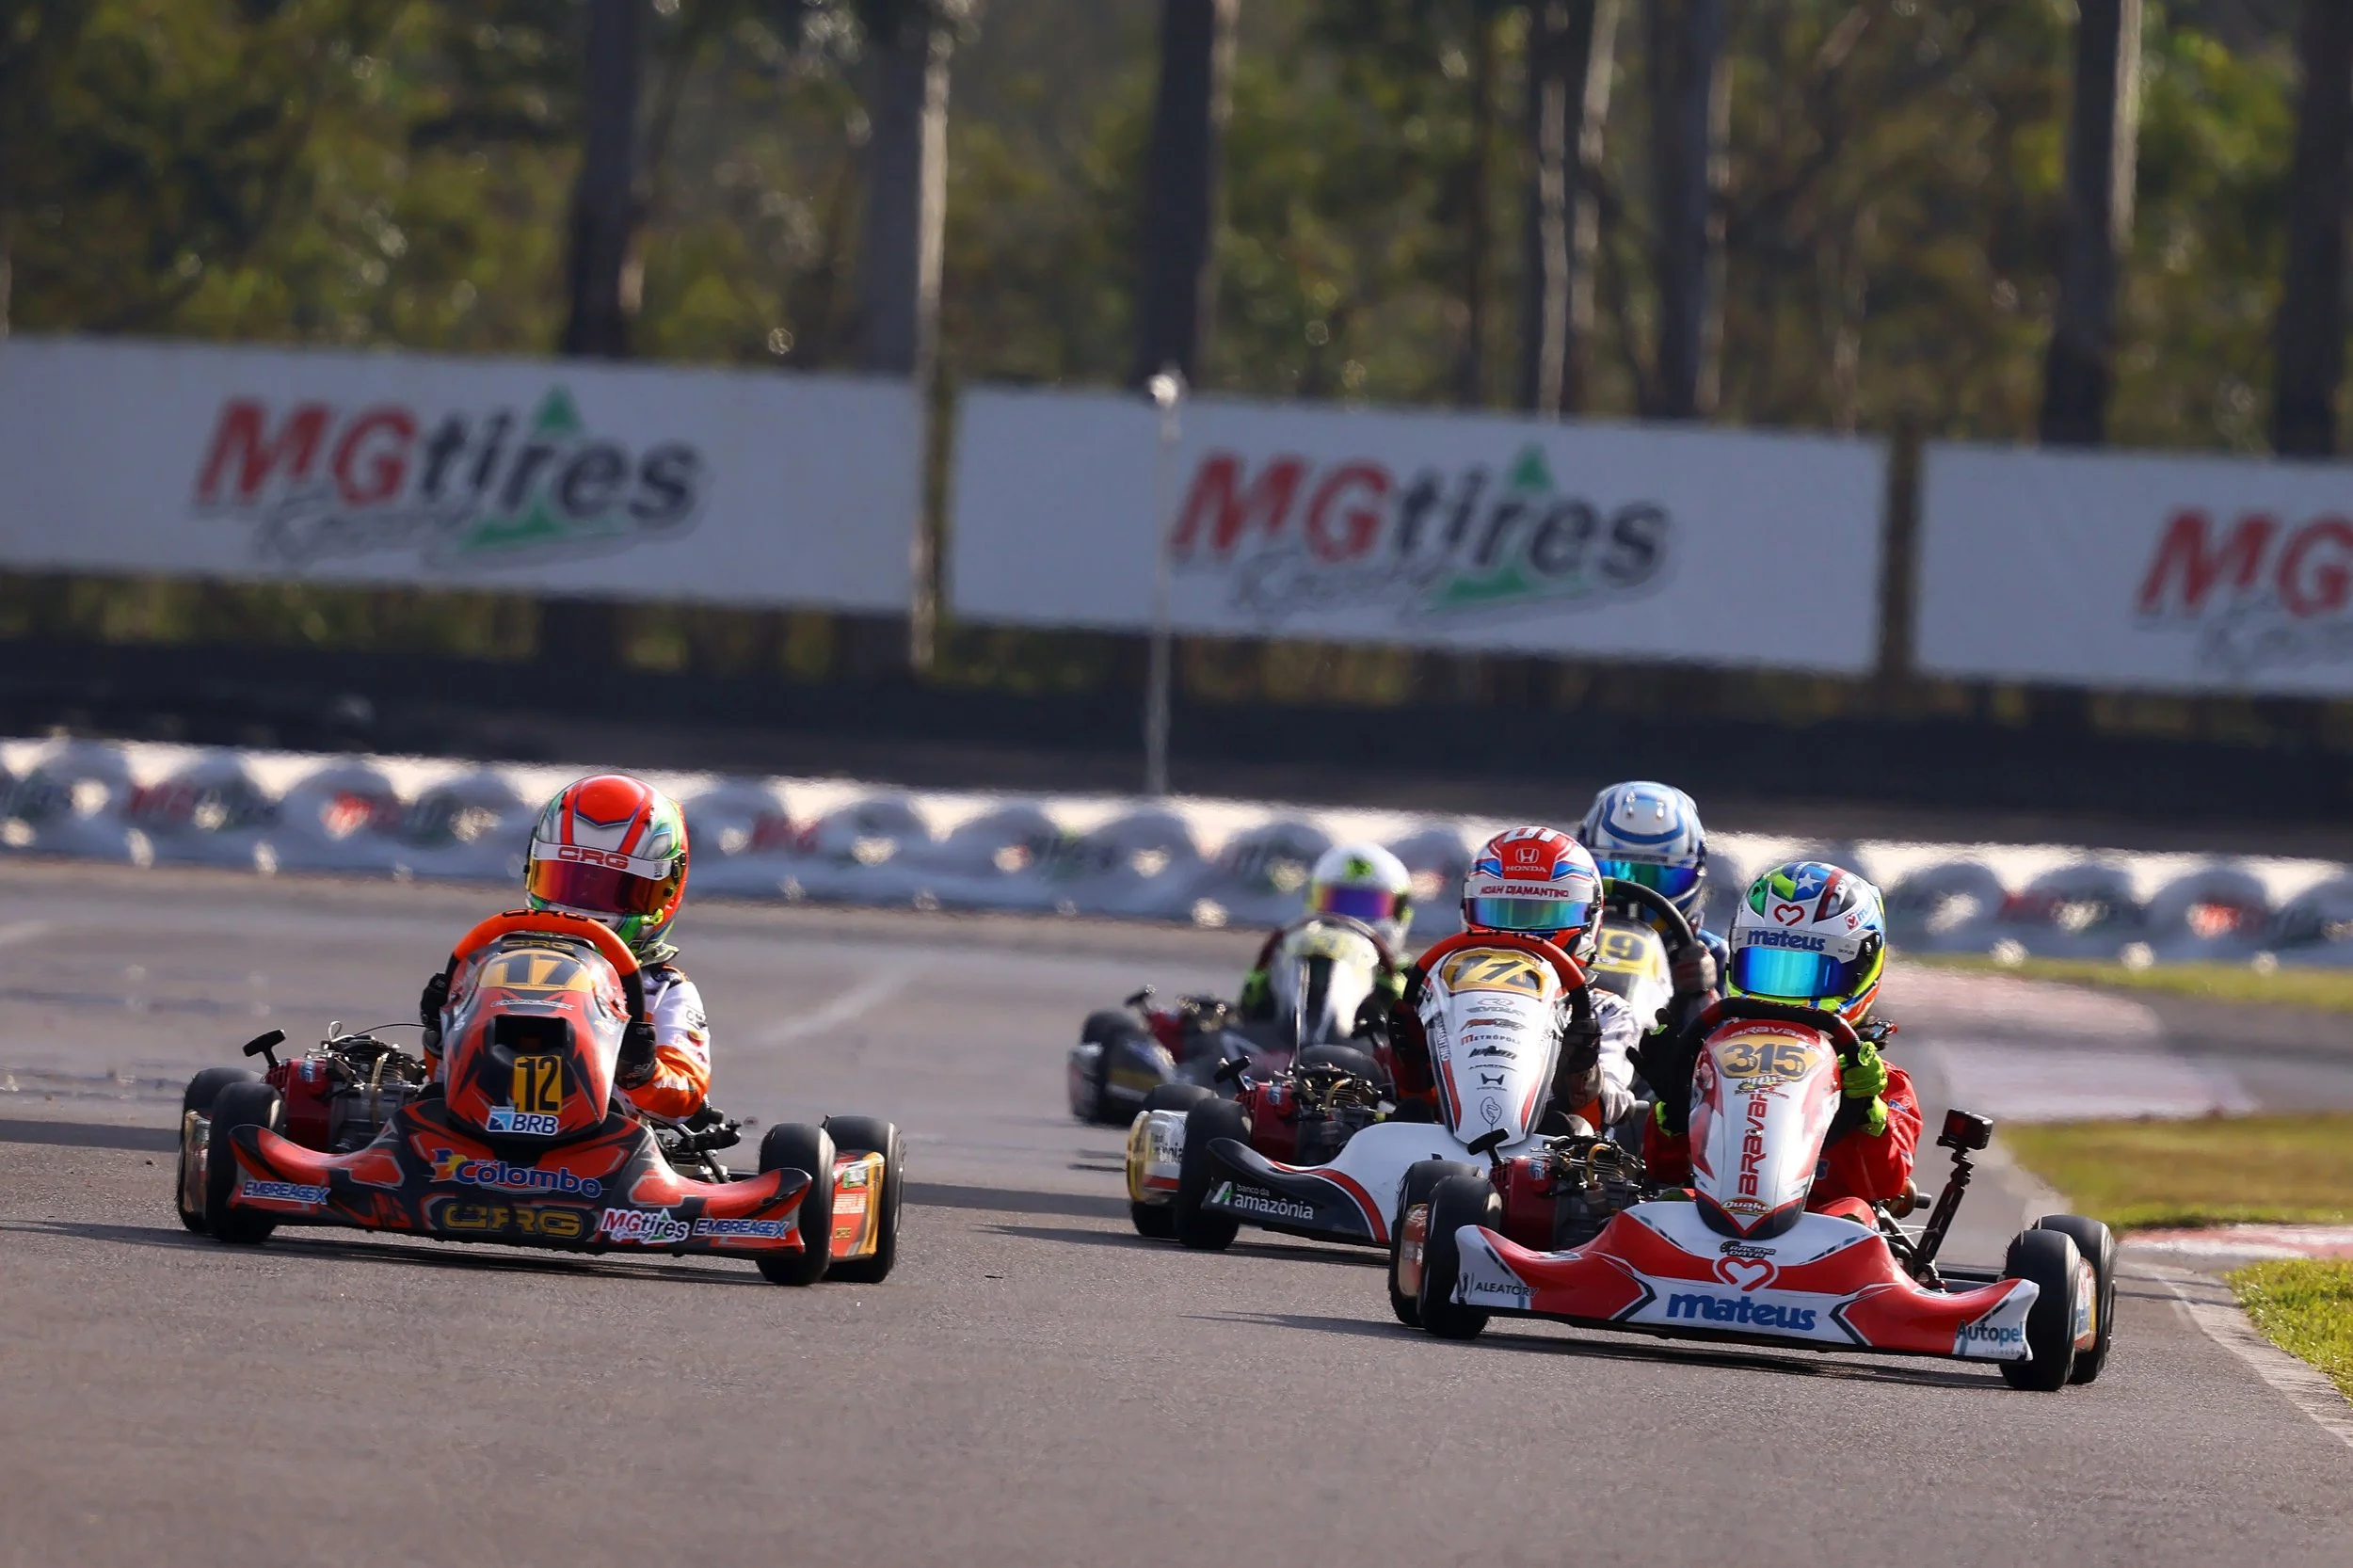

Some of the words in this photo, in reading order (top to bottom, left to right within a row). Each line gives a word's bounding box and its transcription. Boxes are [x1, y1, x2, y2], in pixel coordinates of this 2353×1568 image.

[194, 395, 700, 531] MGtires
[1170, 452, 1672, 588] MGtires
[558, 846, 630, 871] CRG
[1481, 886, 1503, 894] NOAH
[1505, 886, 1569, 898] DIAMANTINO
[1748, 930, 1825, 952] mateus
[494, 952, 581, 987] 17
[1724, 1043, 1806, 1077] 315
[518, 1056, 558, 1112] 12
[511, 1113, 557, 1135] BRB
[455, 1159, 601, 1198] Colombo
[1237, 1184, 1259, 1194] banco
[1260, 1188, 1270, 1196] da
[242, 1181, 329, 1205] EMBREAGEX
[1234, 1193, 1314, 1221] amazônia
[602, 1210, 688, 1239] MGtires
[694, 1219, 789, 1240] EMBREAGEX
[1729, 1245, 1776, 1255] RACING
[1666, 1293, 1817, 1331] mateus
[1955, 1320, 2025, 1348] Autopel
